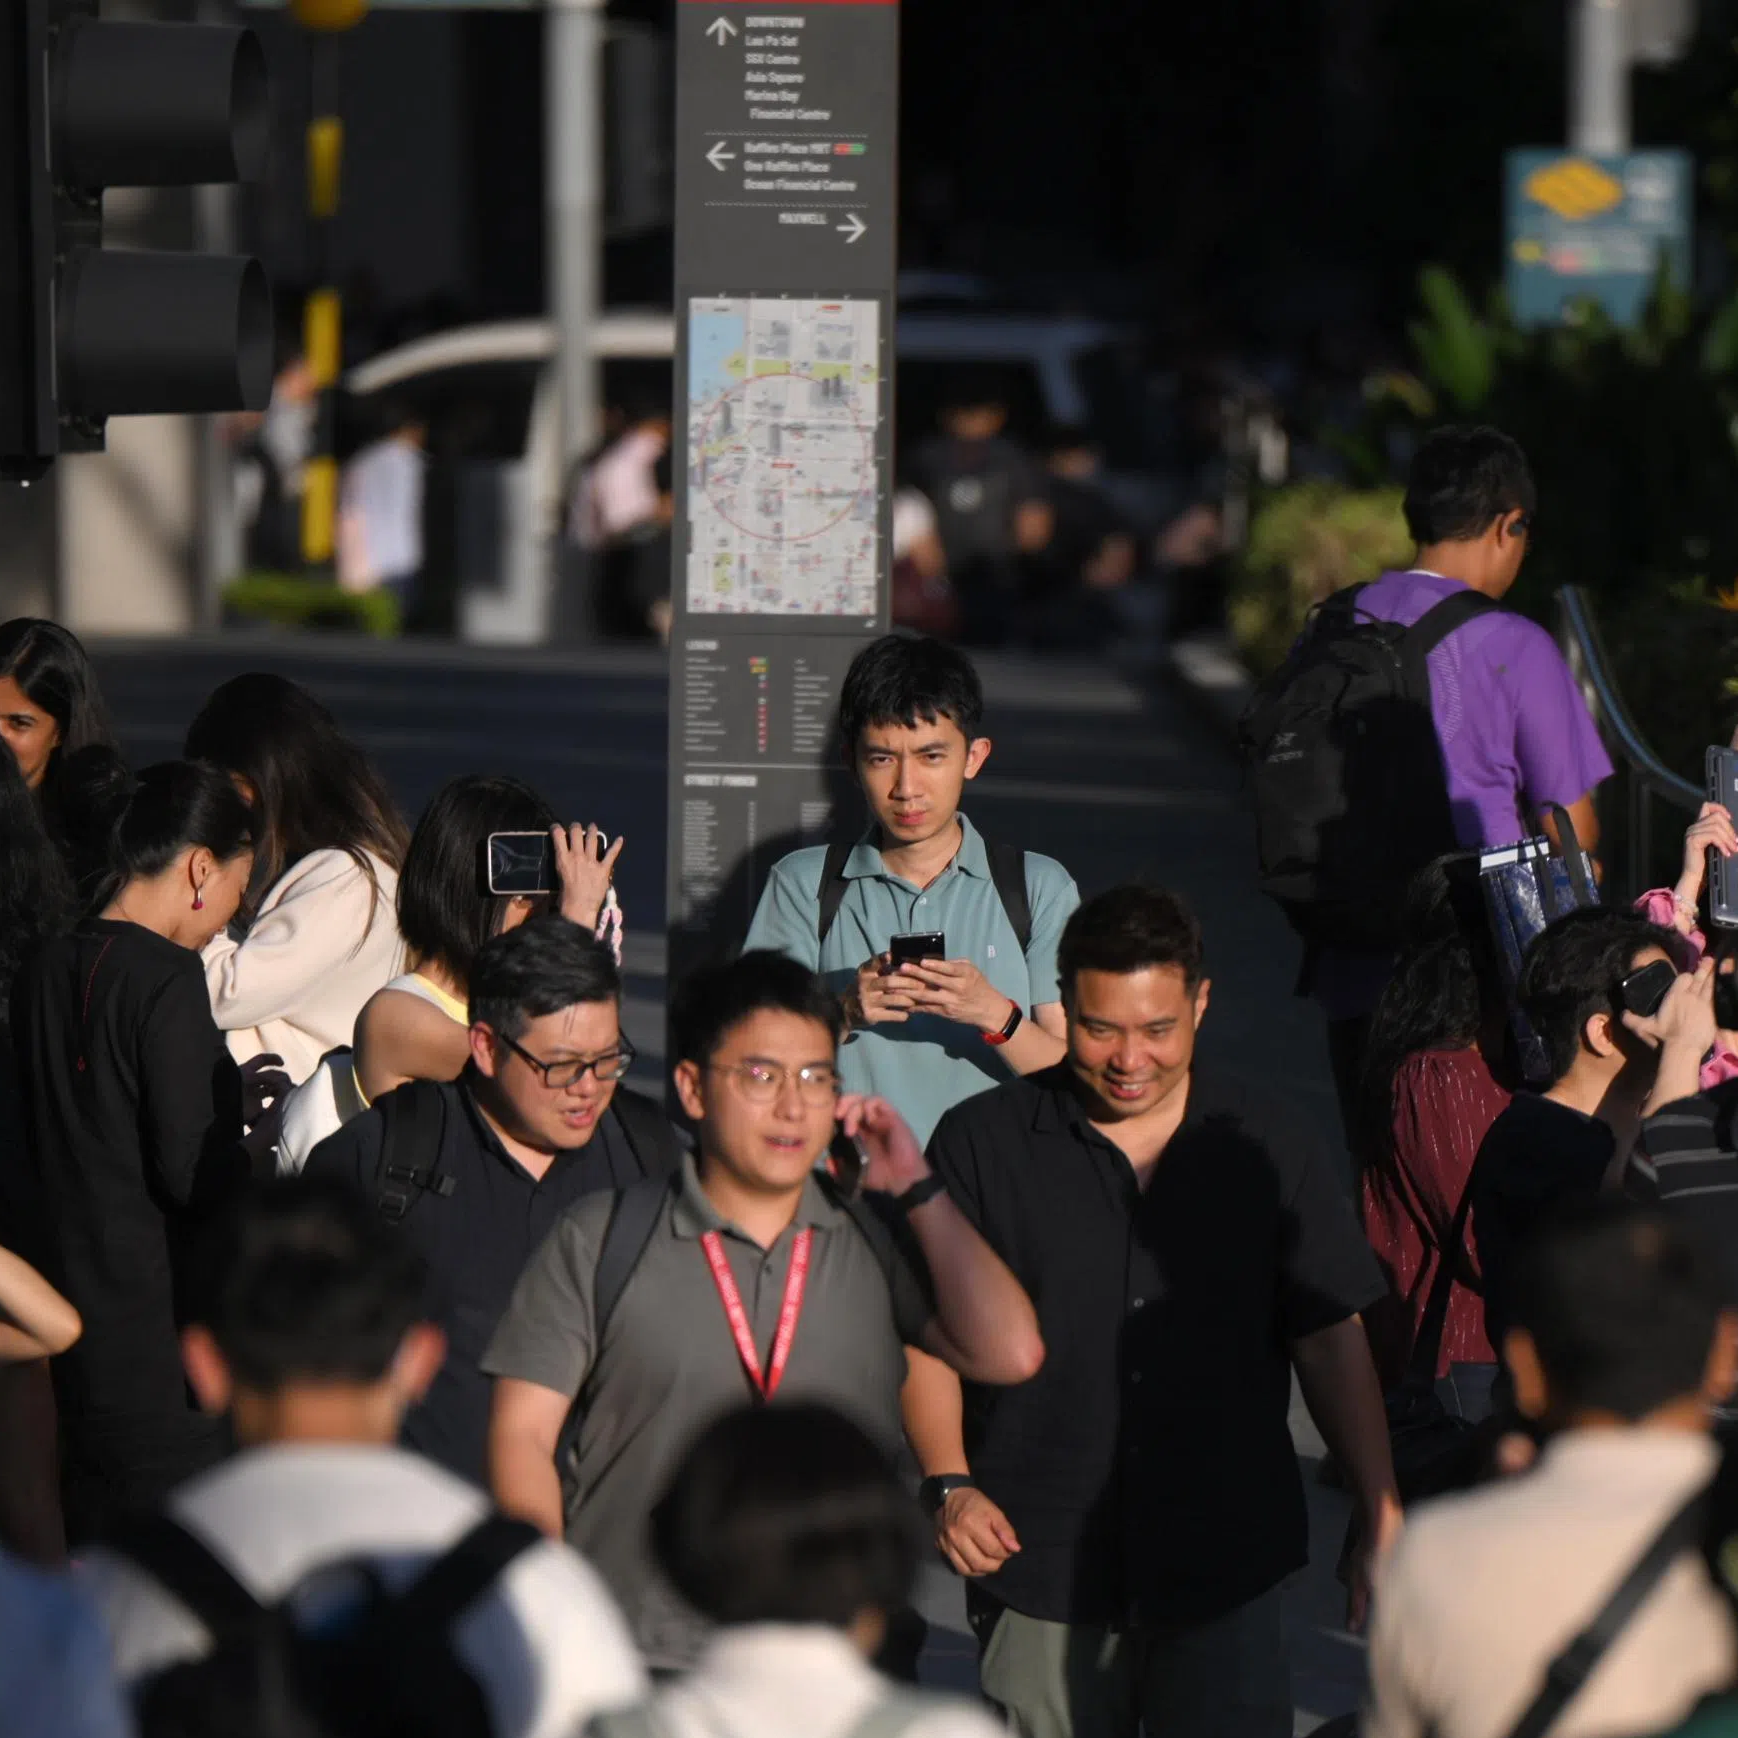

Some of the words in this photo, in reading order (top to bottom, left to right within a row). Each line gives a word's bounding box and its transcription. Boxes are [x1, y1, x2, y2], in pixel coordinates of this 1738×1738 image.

[765, 35, 779, 47] Pa
[780, 35, 798, 47] Sat
[765, 53, 800, 65] Centre
[768, 71, 804, 85] Square
[744, 90, 778, 101] Marina
[779, 90, 800, 104] Bay
[749, 107, 794, 119] Financial
[796, 108, 830, 120] Centre
[744, 142, 780, 154] Raffles
[781, 143, 808, 154] Place
[809, 143, 831, 155] MRT
[800, 161, 830, 173] Place
[775, 179, 821, 191] Financial
[822, 179, 857, 192] Centre
[778, 213, 828, 225] MAXWELL
